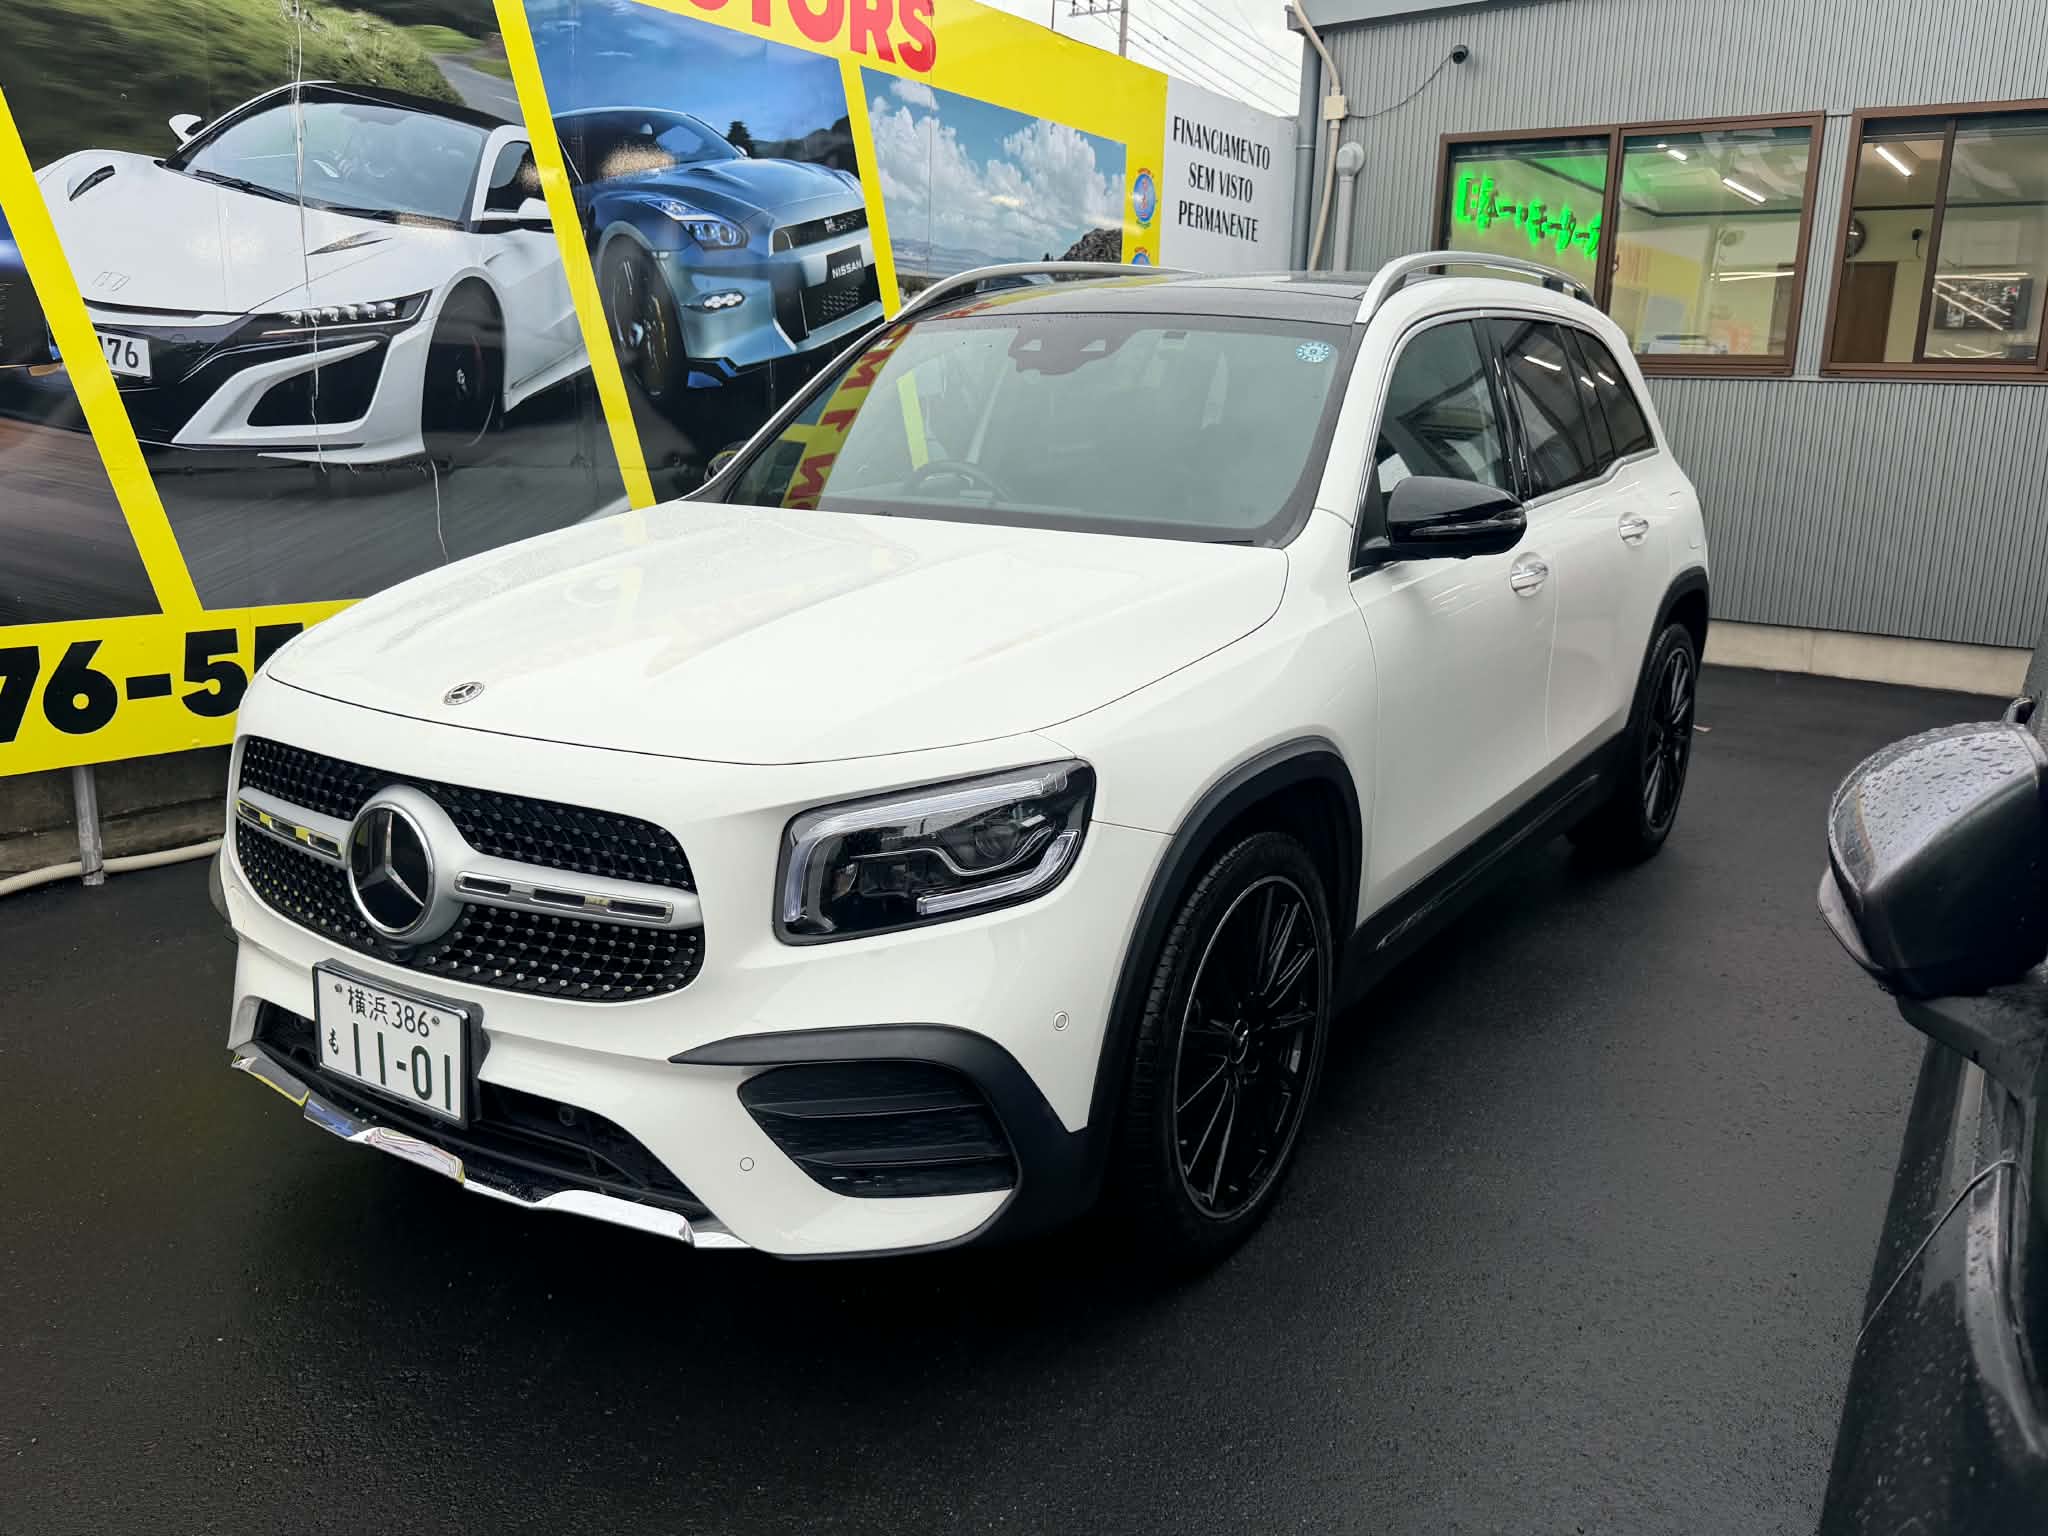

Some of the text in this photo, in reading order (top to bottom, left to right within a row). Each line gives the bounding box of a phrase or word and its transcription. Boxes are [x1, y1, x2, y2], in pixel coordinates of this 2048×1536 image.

[1173, 115, 1270, 170] FINANCIAMENTO
[1188, 162, 1253, 203] SEM VISTO
[1178, 199, 1259, 243] PERMANENTE
[831, 260, 862, 279] NISSAN
[97, 335, 139, 368] 76
[0, 622, 304, 744] 76-5
[353, 1022, 452, 1111] 11-01
